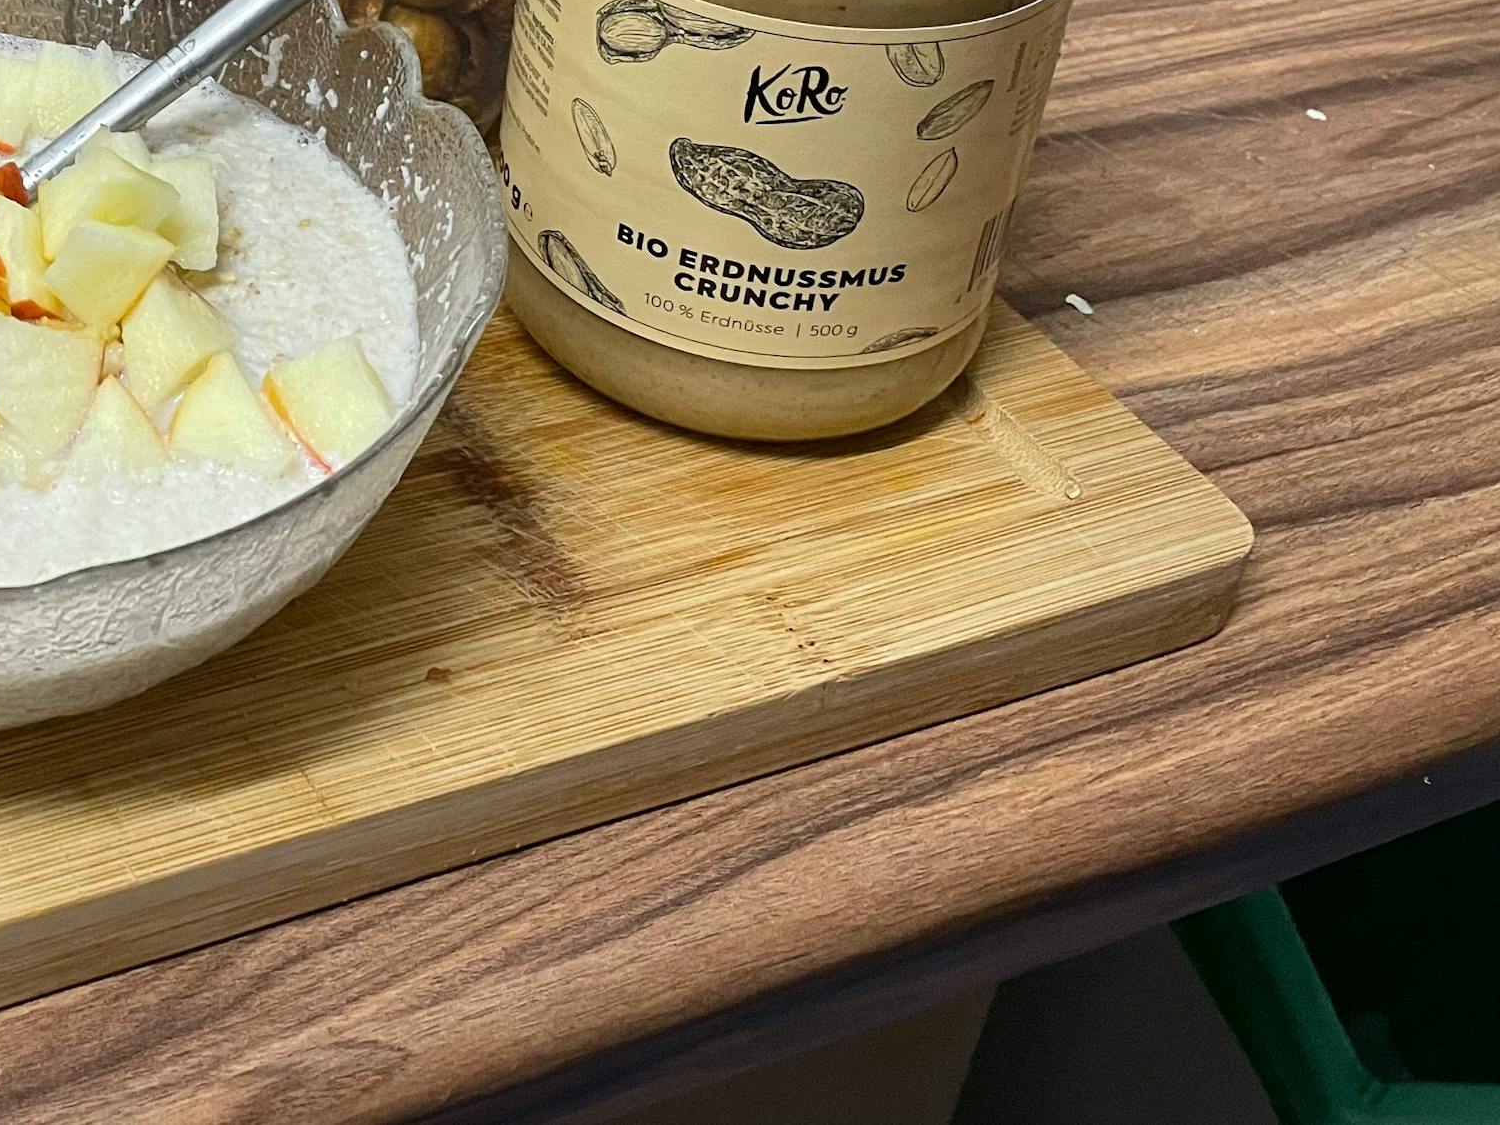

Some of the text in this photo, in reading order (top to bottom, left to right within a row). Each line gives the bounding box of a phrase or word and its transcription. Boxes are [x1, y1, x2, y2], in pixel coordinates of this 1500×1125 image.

[744, 63, 848, 124] KoRo
[617, 223, 906, 289] BIO ERDNUSSMUS
[644, 293, 858, 339] 100 % Erdnüsse 500 g
[674, 273, 840, 311] CRUNCHY
